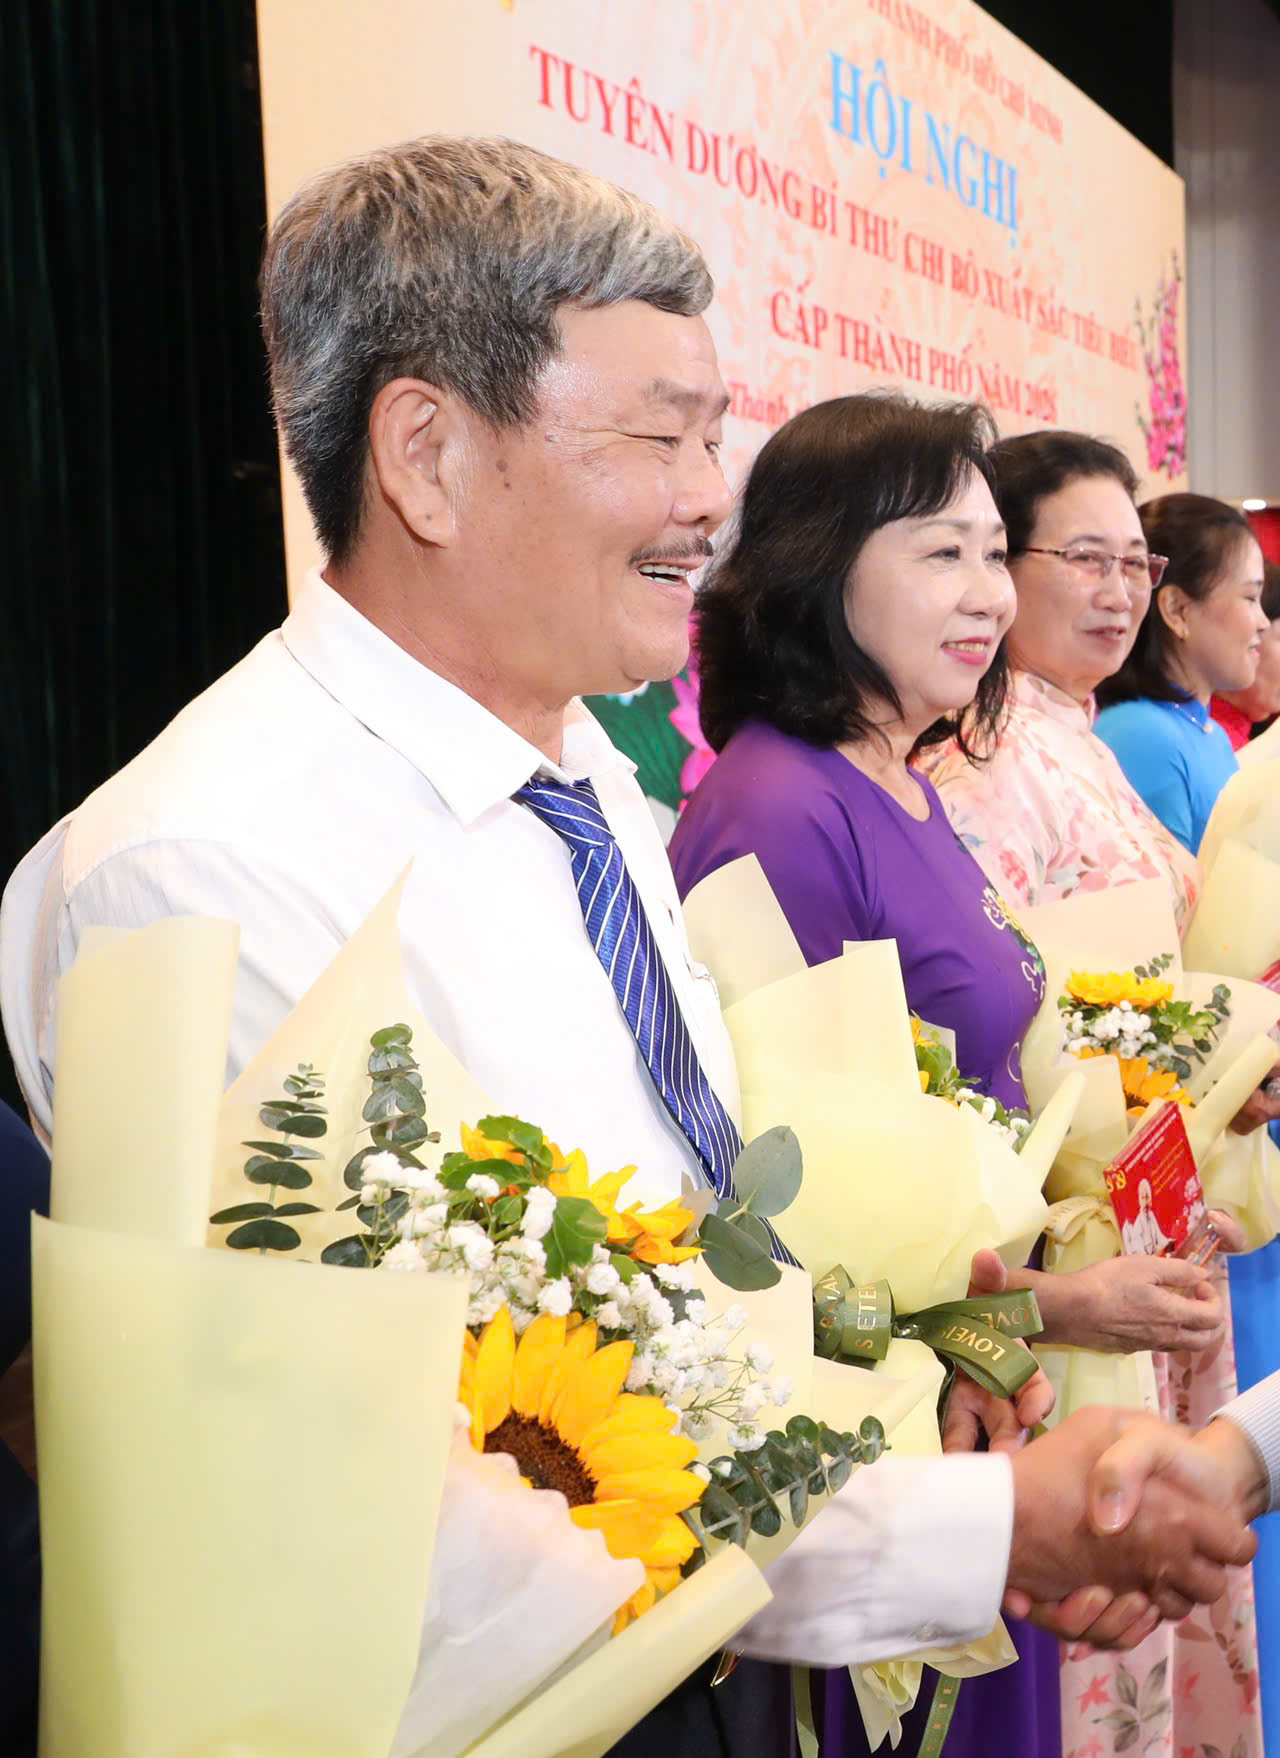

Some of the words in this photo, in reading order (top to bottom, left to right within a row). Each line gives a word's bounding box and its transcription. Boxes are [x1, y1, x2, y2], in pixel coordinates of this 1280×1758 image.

[529, 43, 676, 164] TUYÊN
[685, 120, 802, 219] DƯƠNG
[810, 180, 838, 237] BÍ
[844, 201, 898, 263] THƯ
[903, 232, 944, 285] CHI
[829, 50, 912, 180] HỘI
[924, 112, 1018, 249] NGHỊ
[771, 278, 829, 350] CẤP
[835, 313, 922, 382] THÀNH
[928, 342, 973, 396] PHỐ
